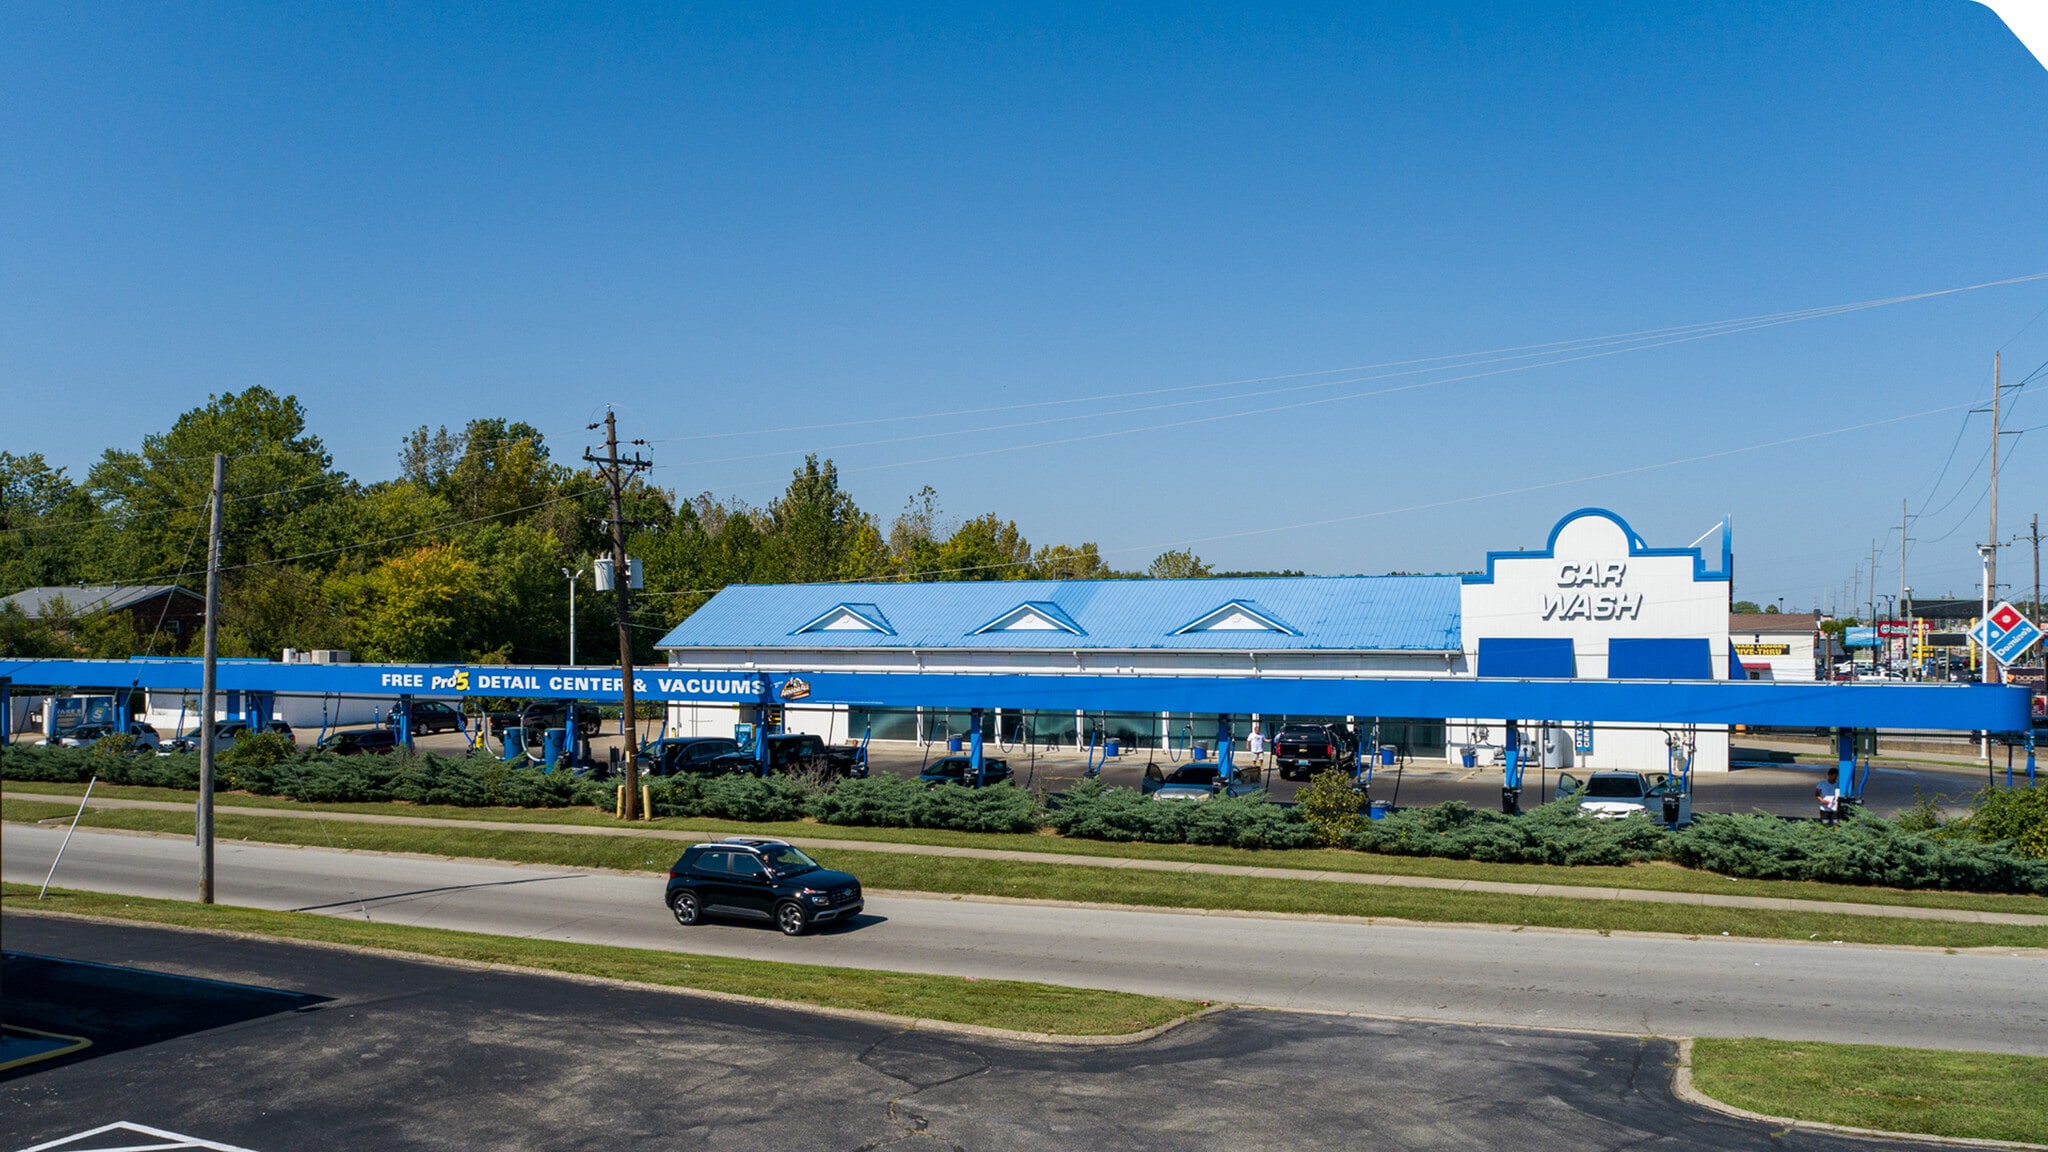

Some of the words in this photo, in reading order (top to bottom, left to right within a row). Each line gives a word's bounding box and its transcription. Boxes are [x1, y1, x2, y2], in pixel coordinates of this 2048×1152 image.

[1557, 559, 1627, 588] CAR
[1539, 592, 1644, 621] WASH
[1997, 626, 2033, 657] Domino's
[381, 673, 423, 687] FREE
[478, 675, 541, 690] DETAIL
[549, 676, 624, 691] CENTER
[633, 678, 648, 692] &
[657, 678, 766, 695] VACUUMS
